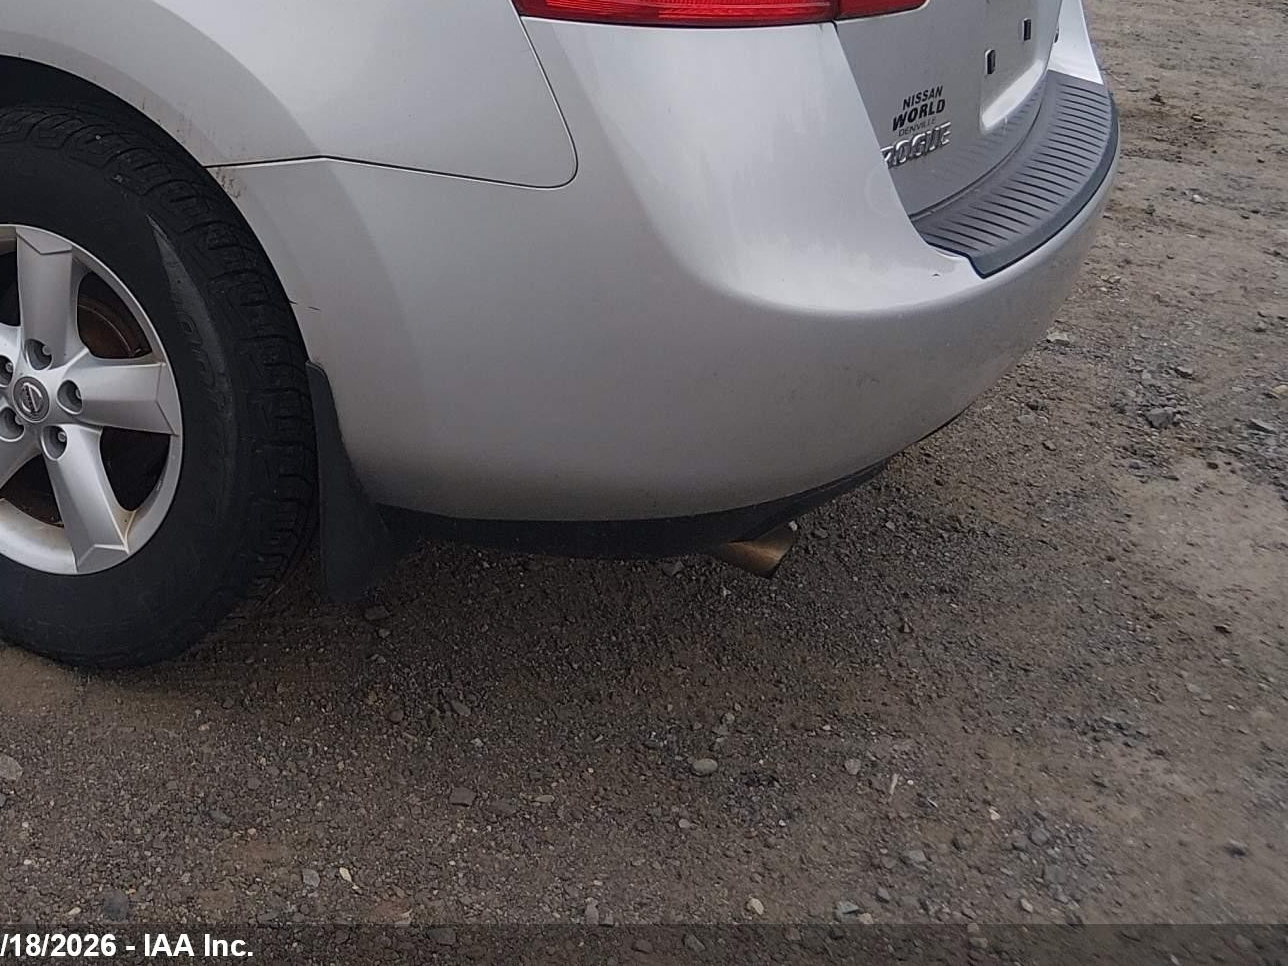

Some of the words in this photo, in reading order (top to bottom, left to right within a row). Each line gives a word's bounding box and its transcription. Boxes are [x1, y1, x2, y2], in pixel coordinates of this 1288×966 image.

[902, 85, 943, 110] NISSAN
[892, 99, 946, 132] WORLD
[898, 116, 937, 137] DENVILLE
[880, 122, 951, 169] ROGUE
